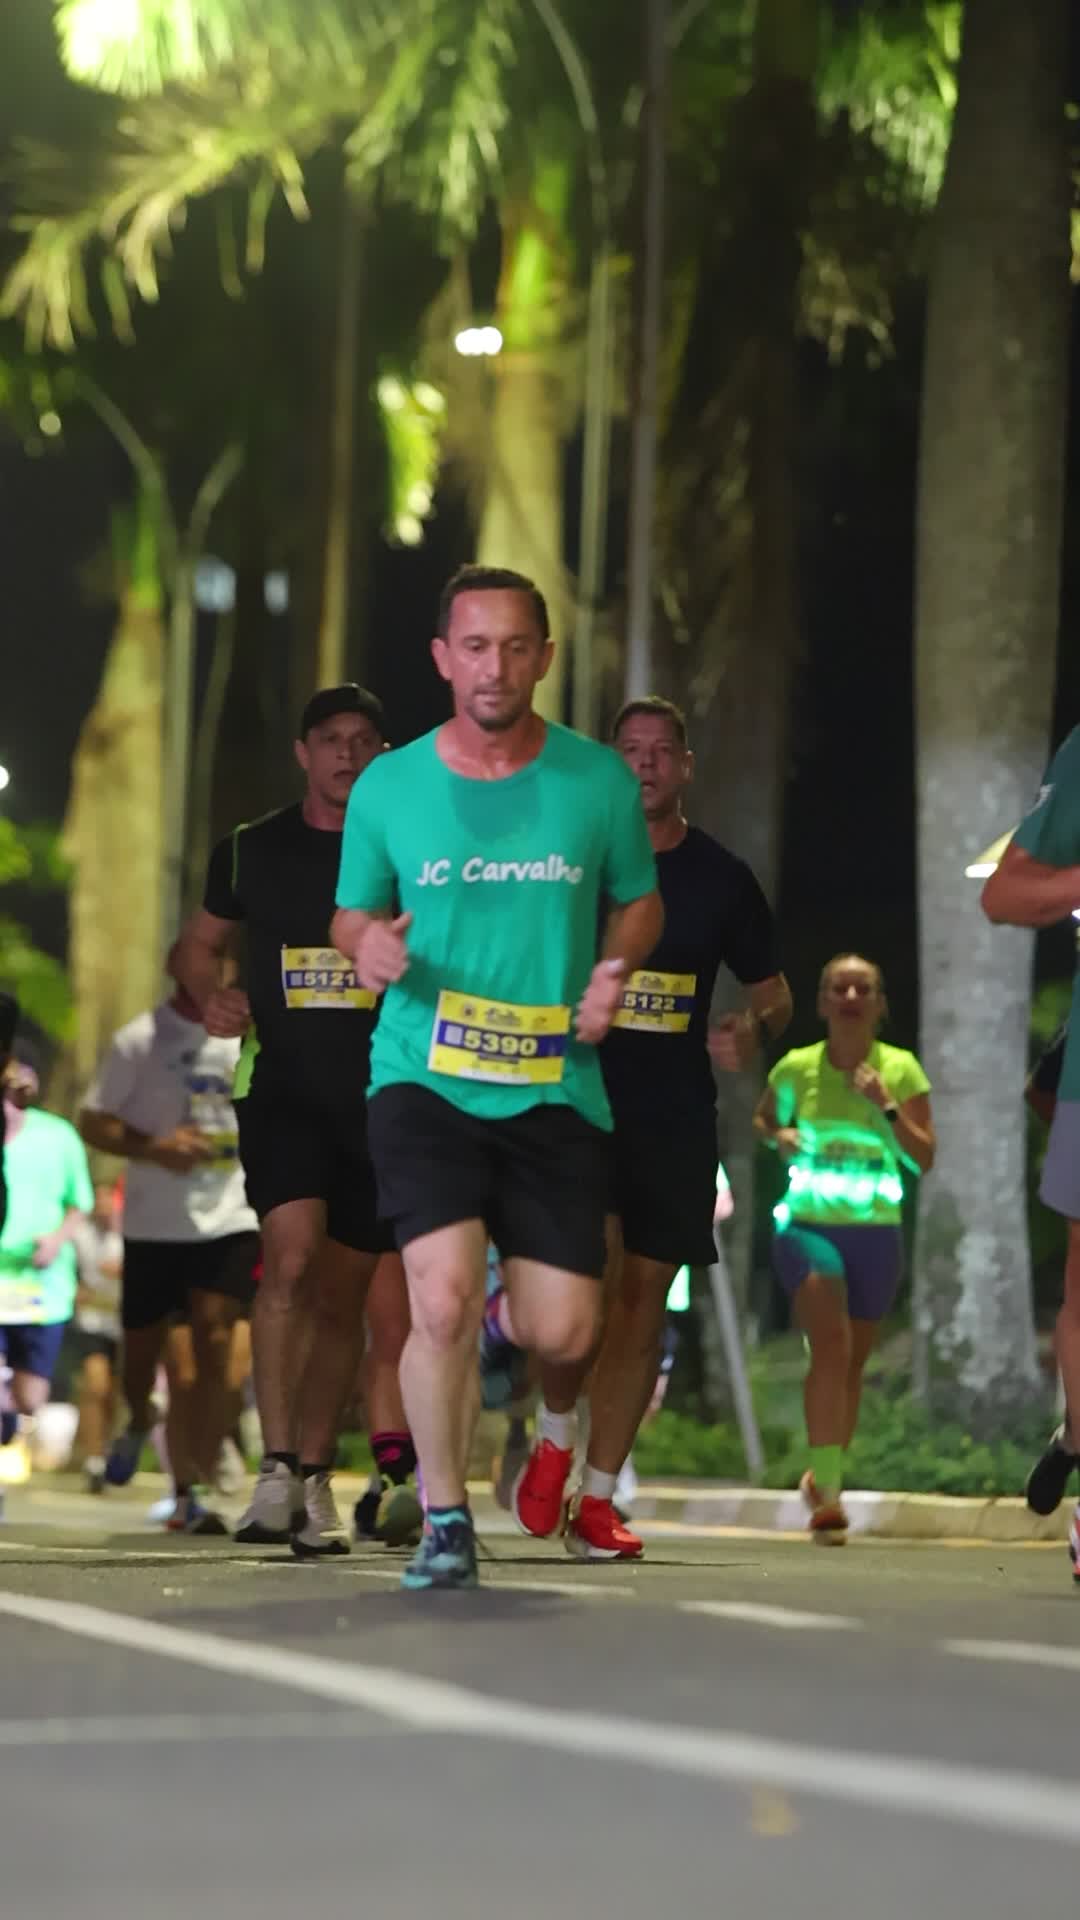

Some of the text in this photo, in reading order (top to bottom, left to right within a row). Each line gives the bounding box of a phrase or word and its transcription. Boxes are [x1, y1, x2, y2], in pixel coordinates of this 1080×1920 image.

[416, 853, 584, 886] JC Carvalho
[304, 971, 355, 987] 5121
[624, 992, 675, 1011] 5122
[463, 1030, 538, 1056] 5390
